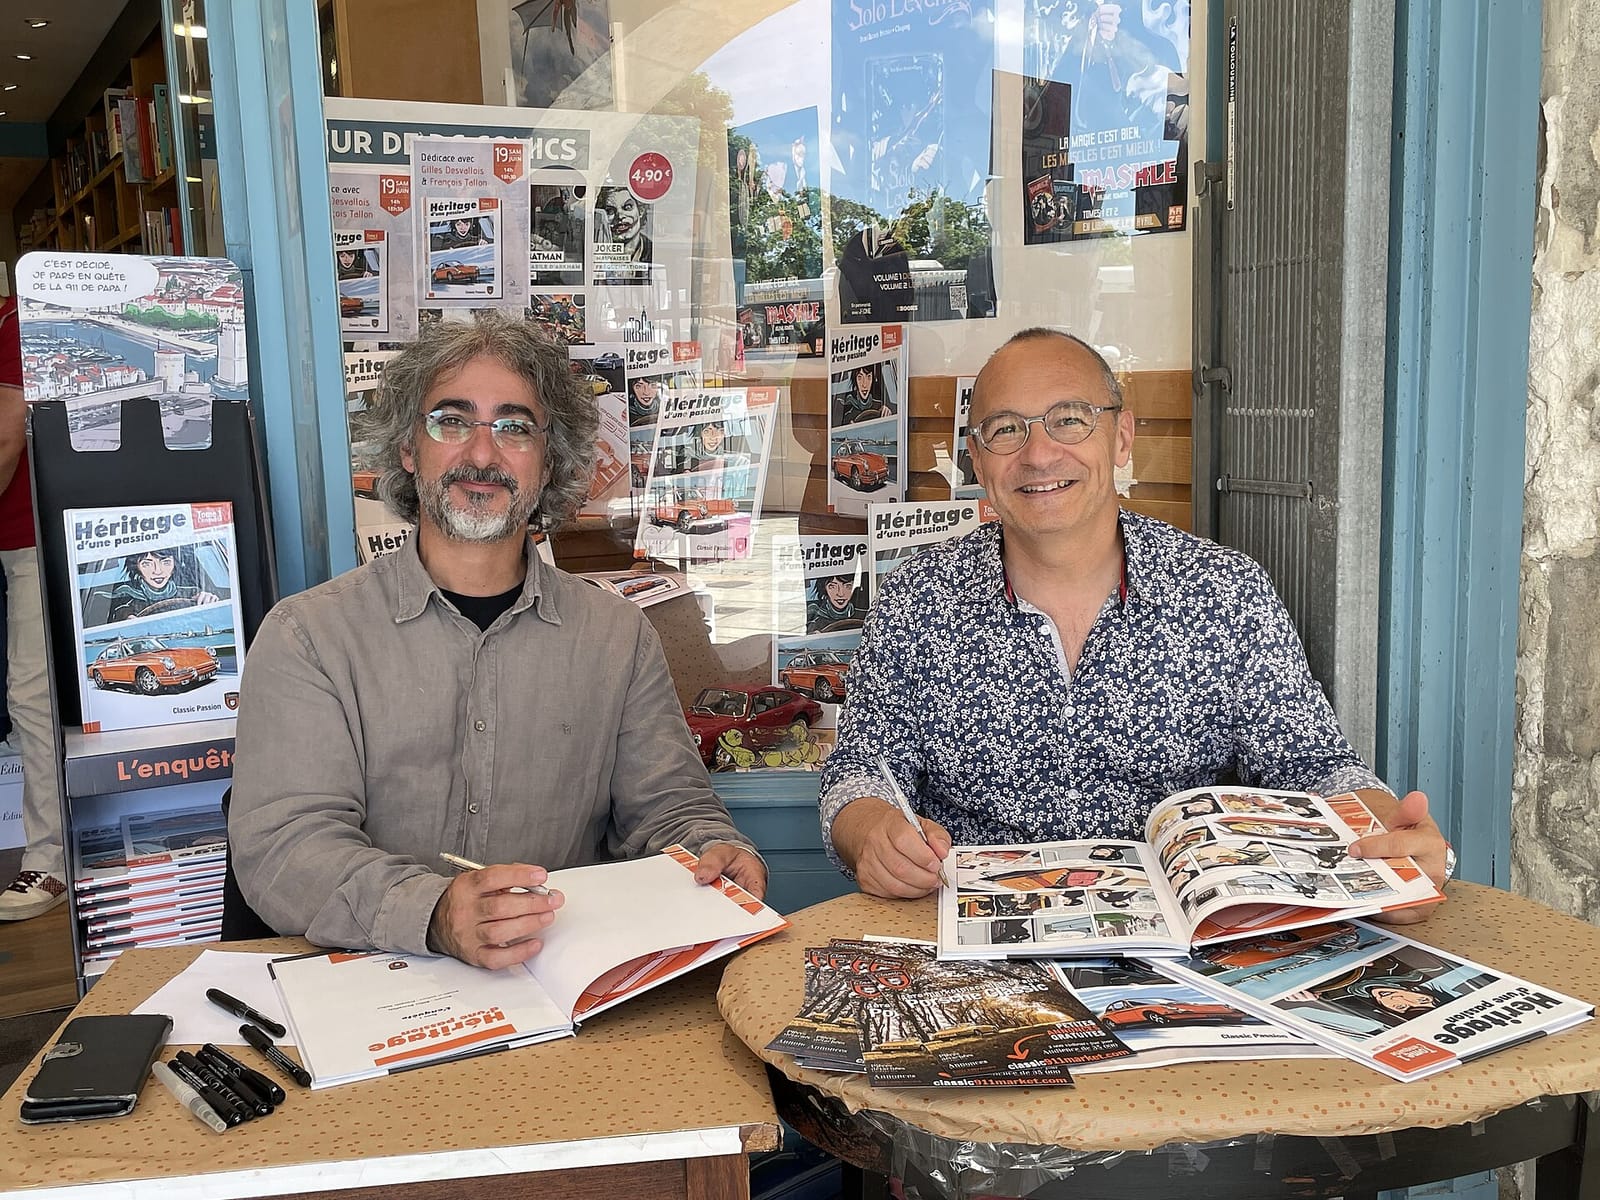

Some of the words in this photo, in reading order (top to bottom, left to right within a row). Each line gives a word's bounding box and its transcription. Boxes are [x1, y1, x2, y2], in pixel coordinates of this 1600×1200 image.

[328, 129, 373, 155] UR
[1059, 136, 1069, 150] LA
[1071, 132, 1095, 149] MAGIE
[1097, 130, 1118, 145] C'EST
[421, 153, 456, 163] Dédicace
[457, 155, 475, 163] avec
[495, 147, 509, 163] 19
[1042, 152, 1057, 169] LES
[1059, 147, 1098, 168] MUSCLES
[421, 165, 443, 175] Gilles
[445, 165, 485, 175] Desvallois
[430, 178, 463, 189] François
[464, 178, 488, 187] Tallon
[1081, 159, 1178, 196] MASHLE
[381, 179, 395, 194] 19
[349, 209, 374, 219] Tallon
[430, 200, 477, 214] Héritage
[595, 244, 623, 253] JOKER
[530, 253, 562, 261] ATMAN
[43, 260, 73, 269] C'EST
[75, 258, 115, 271] DÉCIDÉ,
[32, 271, 46, 280] JE
[49, 271, 75, 281] PARS
[78, 272, 92, 281] EN
[94, 271, 126, 282] QUÊTE
[872, 272, 900, 282] VOLUME
[32, 283, 47, 291] DE
[49, 283, 63, 291] LA
[65, 284, 79, 292] 911
[81, 284, 95, 292] DE
[97, 284, 121, 292] PAPA
[880, 282, 904, 291] VOLUME
[764, 301, 820, 326] MASHLE
[831, 333, 880, 356] Héritage
[831, 353, 846, 364] d'une
[847, 351, 867, 362] passion
[627, 362, 649, 370] ssion
[664, 393, 744, 413] Héritage
[664, 410, 688, 420] d'une
[689, 406, 721, 418] passion
[874, 507, 975, 531] Héritage
[74, 513, 187, 541] Héritage
[876, 528, 906, 540] d'une
[909, 524, 949, 538] passion
[77, 538, 111, 551] d'une
[114, 532, 160, 548] passion
[367, 530, 413, 553] Héri
[778, 541, 868, 563] Héritage
[808, 557, 845, 570] passion
[172, 705, 196, 714] Classic
[197, 703, 222, 712] Passion
[904, 992, 983, 1009] Porsche
[983, 982, 1049, 999] Classic
[1492, 986, 1529, 1005] d'une
[459, 1006, 500, 1020] d'une
[1433, 991, 1564, 1045] Héritage
[1445, 1001, 1491, 1024] passion
[400, 1017, 455, 1036] passion
[1055, 1019, 1097, 1029] PETITES
[367, 1011, 506, 1054] Héritage
[1050, 1030, 1106, 1041] GRATUITES
[948, 1059, 989, 1069] Annonces
[1007, 1050, 1130, 1070] classic911market.com
[873, 1072, 917, 1080] Annonces
[933, 1076, 1068, 1087] classic911market.com
